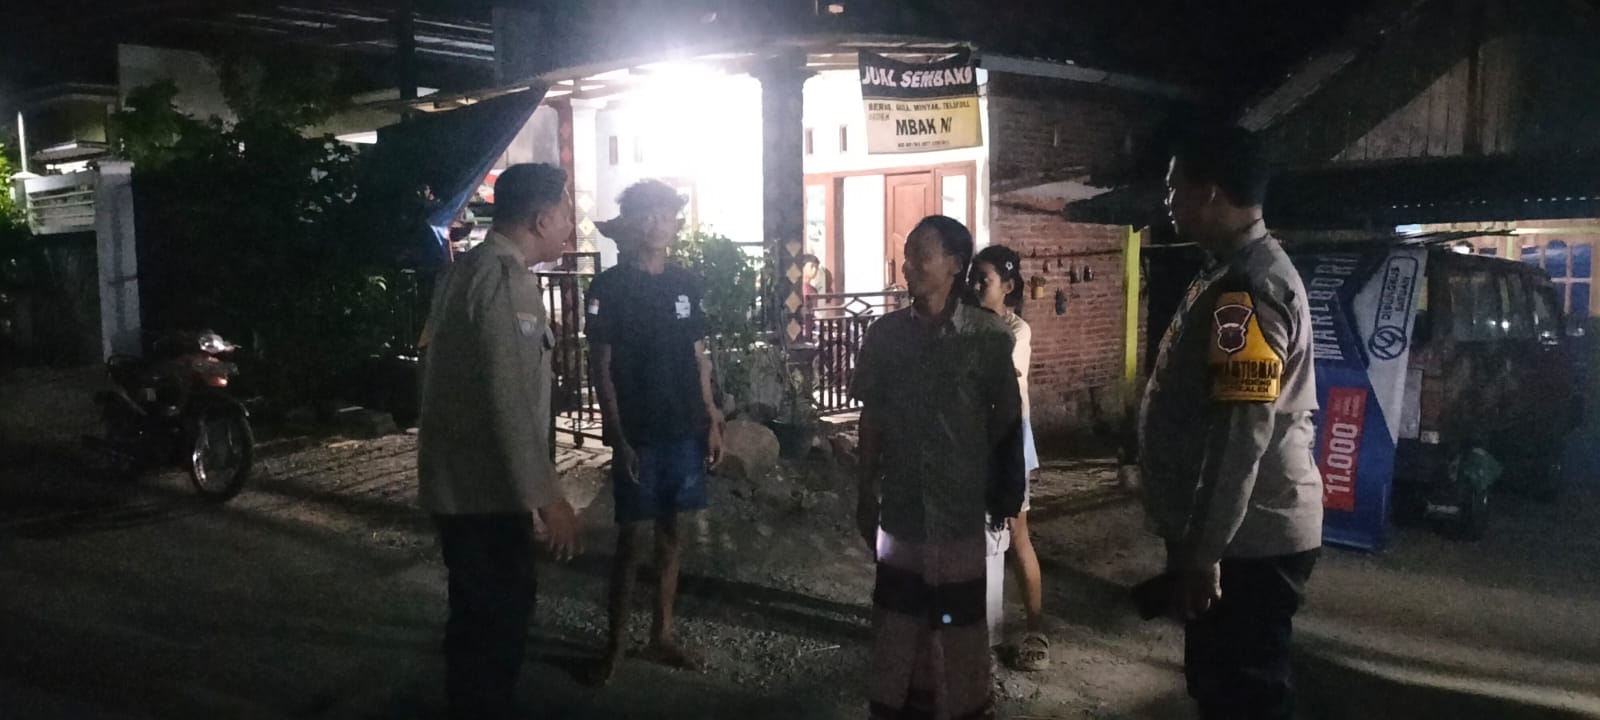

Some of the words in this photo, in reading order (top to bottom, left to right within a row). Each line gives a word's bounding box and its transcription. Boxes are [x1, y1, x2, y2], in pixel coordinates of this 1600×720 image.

[862, 66, 897, 87] JUAL
[900, 66, 973, 88] SEMBAKO
[896, 118, 937, 136] MBAK
